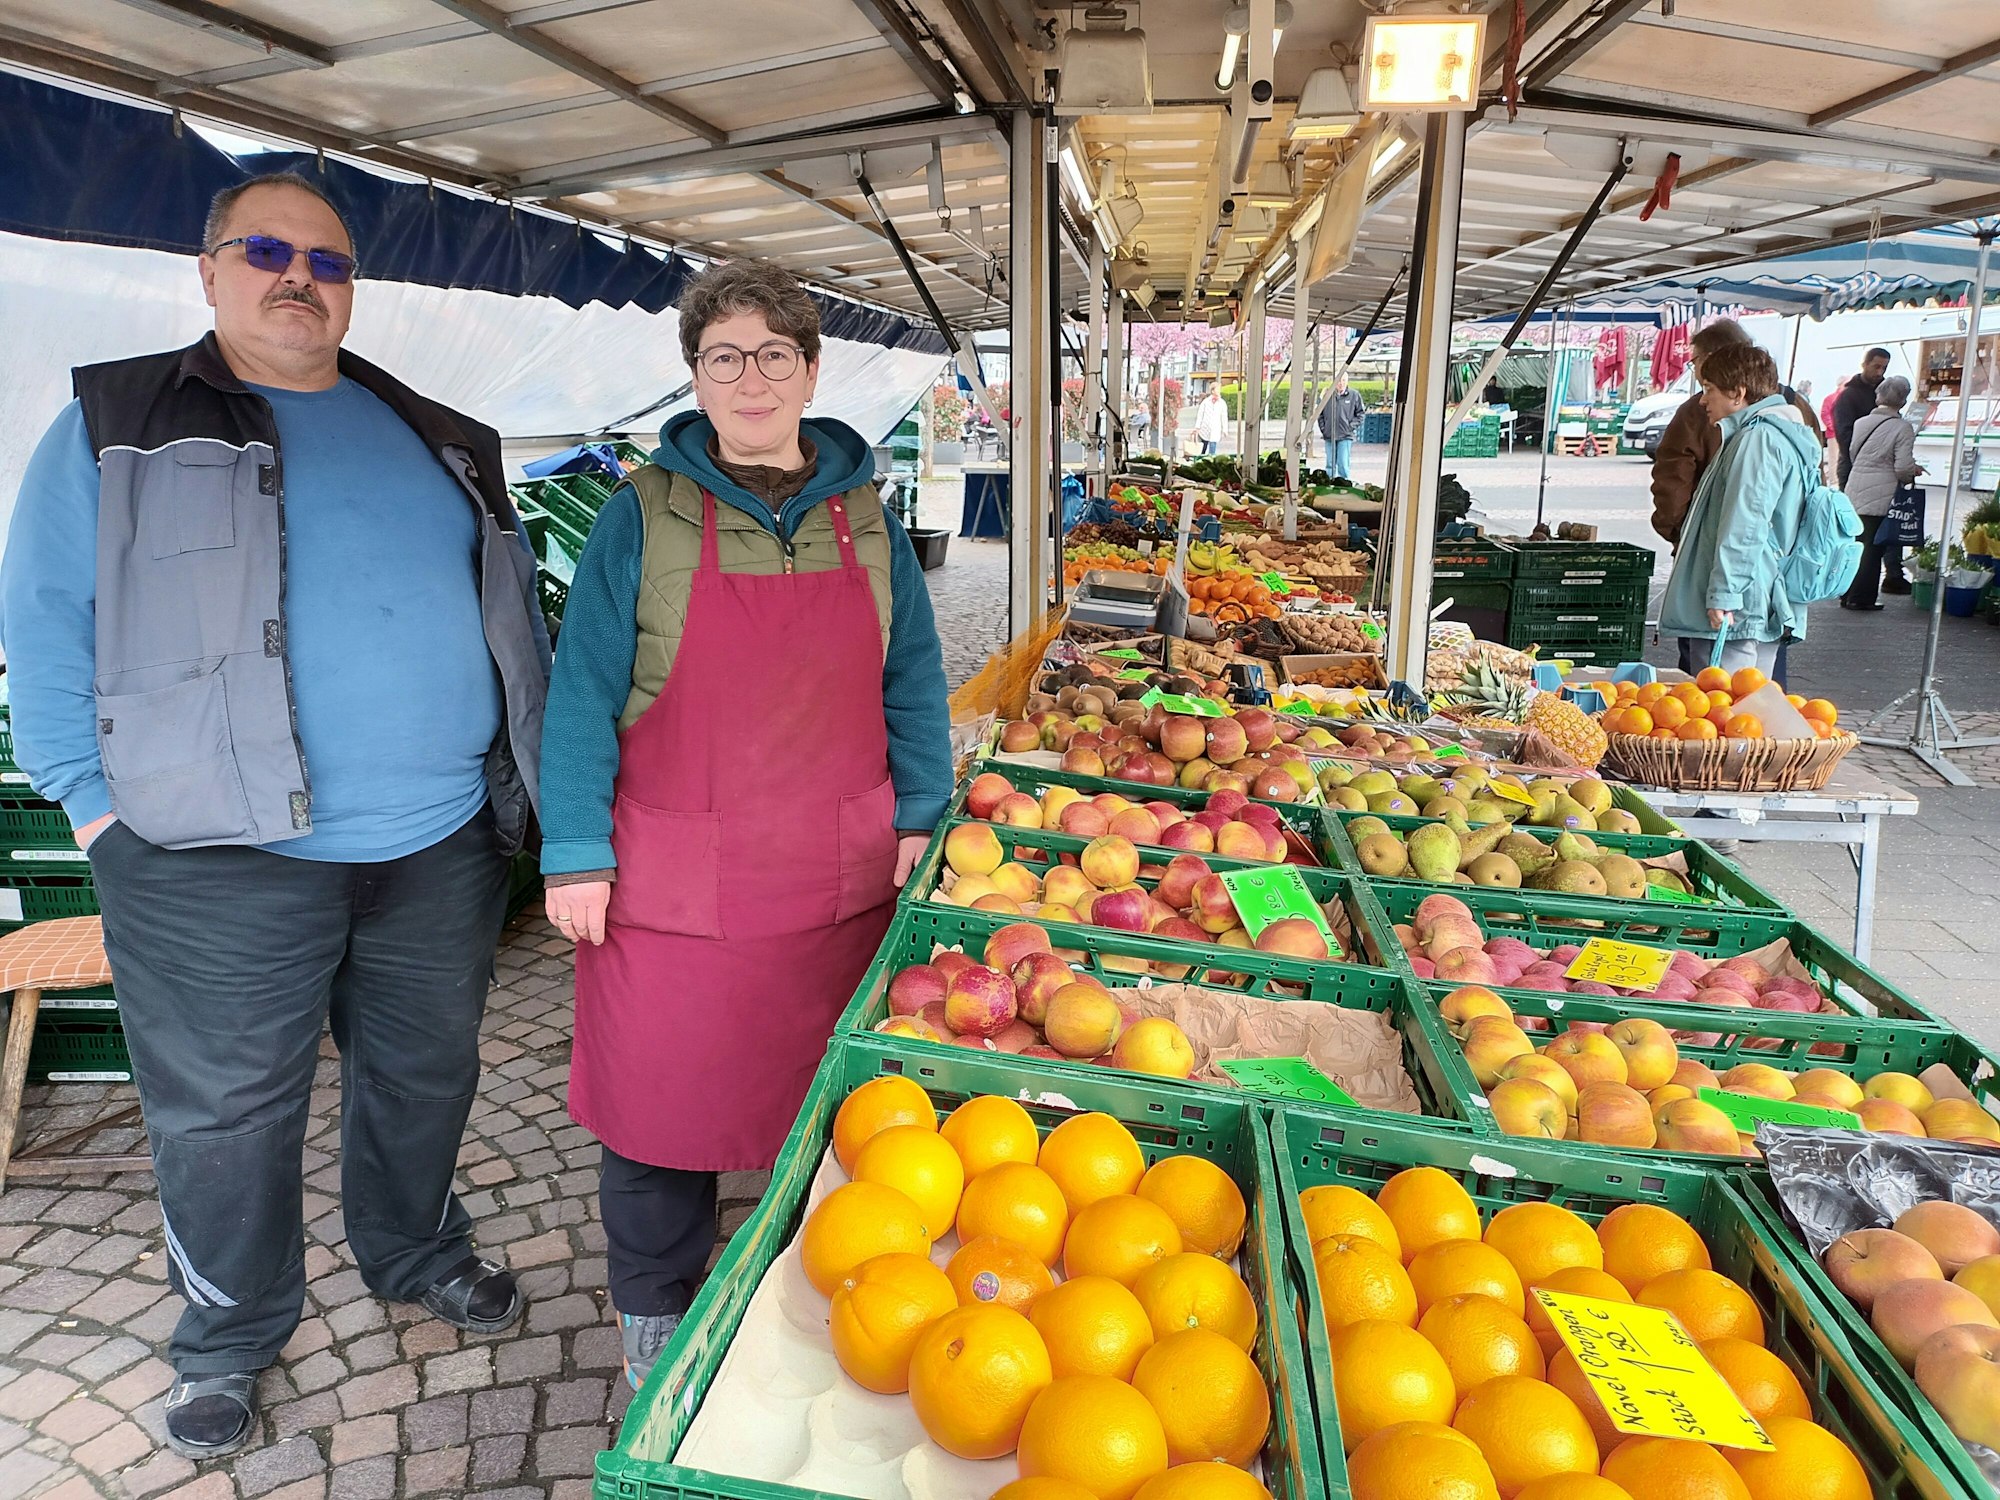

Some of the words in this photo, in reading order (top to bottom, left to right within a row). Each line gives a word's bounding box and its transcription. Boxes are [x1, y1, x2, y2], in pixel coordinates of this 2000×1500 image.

[1250, 877, 1264, 886] €
[1266, 894, 1281, 909] 80
[1586, 1308, 1610, 1321] €
[1558, 1309, 1609, 1368] Orangen
[1606, 1331, 1636, 1354] 50
[1617, 1356, 1695, 1374] 1
[1587, 1372, 1650, 1430] Navel
[1645, 1389, 1706, 1435] Stück
